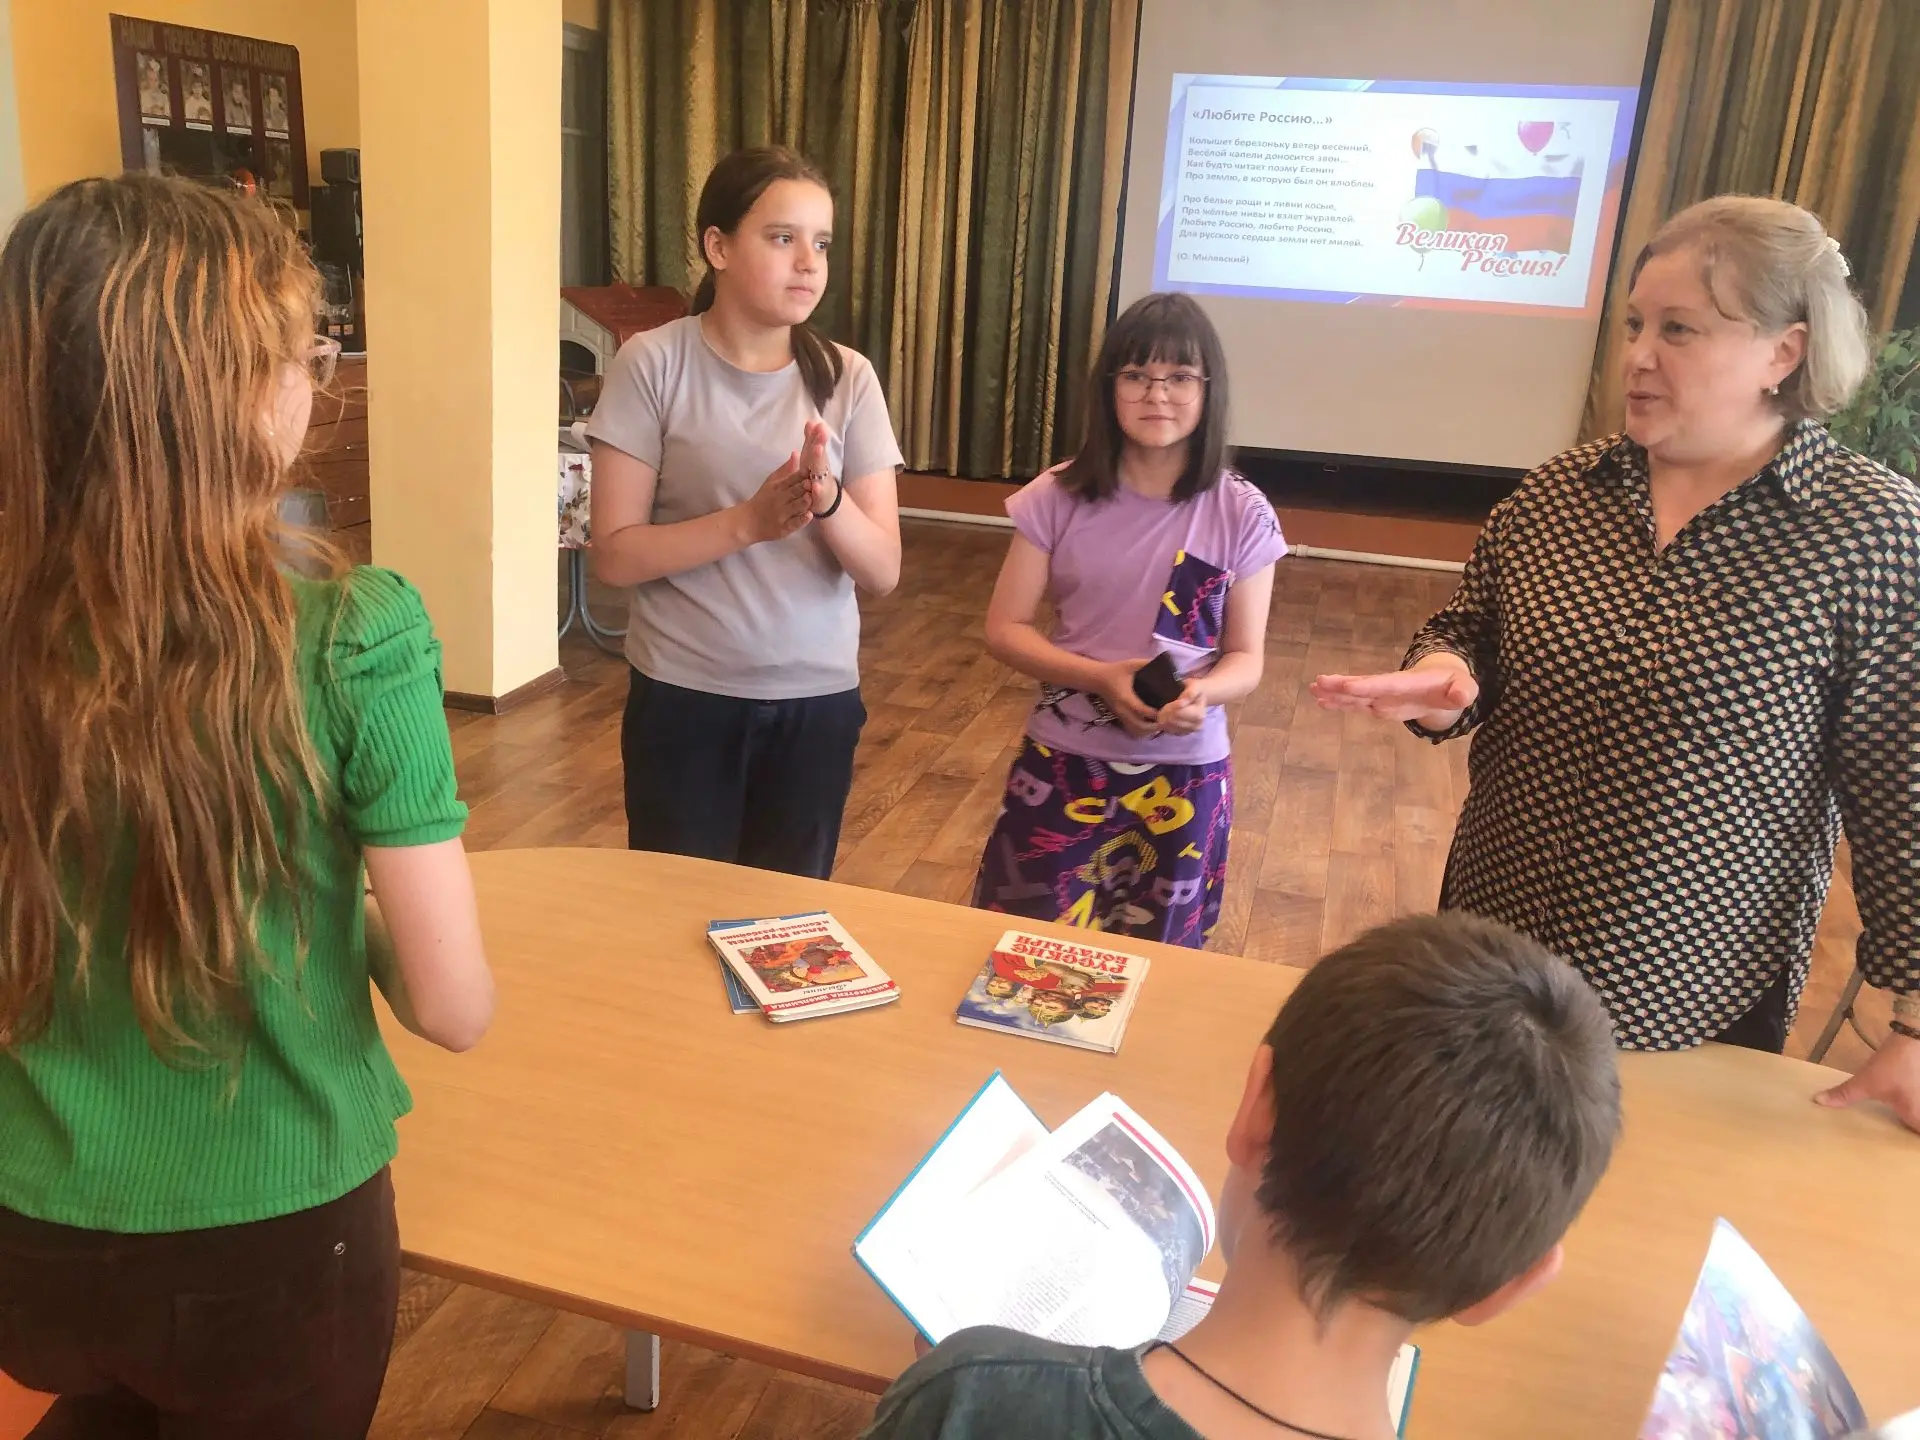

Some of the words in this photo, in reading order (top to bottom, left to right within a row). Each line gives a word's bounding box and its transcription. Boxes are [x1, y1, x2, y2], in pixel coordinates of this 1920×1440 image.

[1192, 109, 1256, 122] «Любите
[1189, 137, 1232, 146] Колышет
[1234, 138, 1290, 149] березоньку
[1292, 142, 1320, 151] ветер
[1229, 151, 1263, 159] капели
[1264, 153, 1315, 161] доносится
[1186, 160, 1204, 168] Как
[1205, 160, 1232, 169] будто
[1235, 163, 1266, 171] читает
[1268, 165, 1298, 174] поэму
[1300, 165, 1334, 174] Есенин
[1185, 172, 1204, 180] Про
[1251, 177, 1291, 186] которую
[1294, 176, 1313, 185] был
[1183, 195, 1201, 204] Про
[1204, 196, 1233, 205] белые
[1236, 199, 1261, 207] рощи
[1182, 206, 1200, 215] Про
[1181, 217, 1217, 227] Любите
[1259, 223, 1294, 231] любите
[1178, 230, 1198, 238] Для
[1200, 231, 1240, 240] русского
[1242, 234, 1275, 243] сердца
[1279, 236, 1308, 244] земли
[1396, 223, 1507, 251] Великая
[1460, 249, 1567, 277] Россия!
[719, 921, 822, 941] Соловей-разбойник
[793, 926, 829, 938] Илья
[727, 932, 790, 946] Муромец
[1014, 935, 1130, 966] БОГАТЫРИ
[1010, 943, 1127, 974] РУССКИЕ
[832, 983, 890, 999] БИБЛИОТЕКА
[770, 994, 828, 1010] ШКОЛЬНИКА
